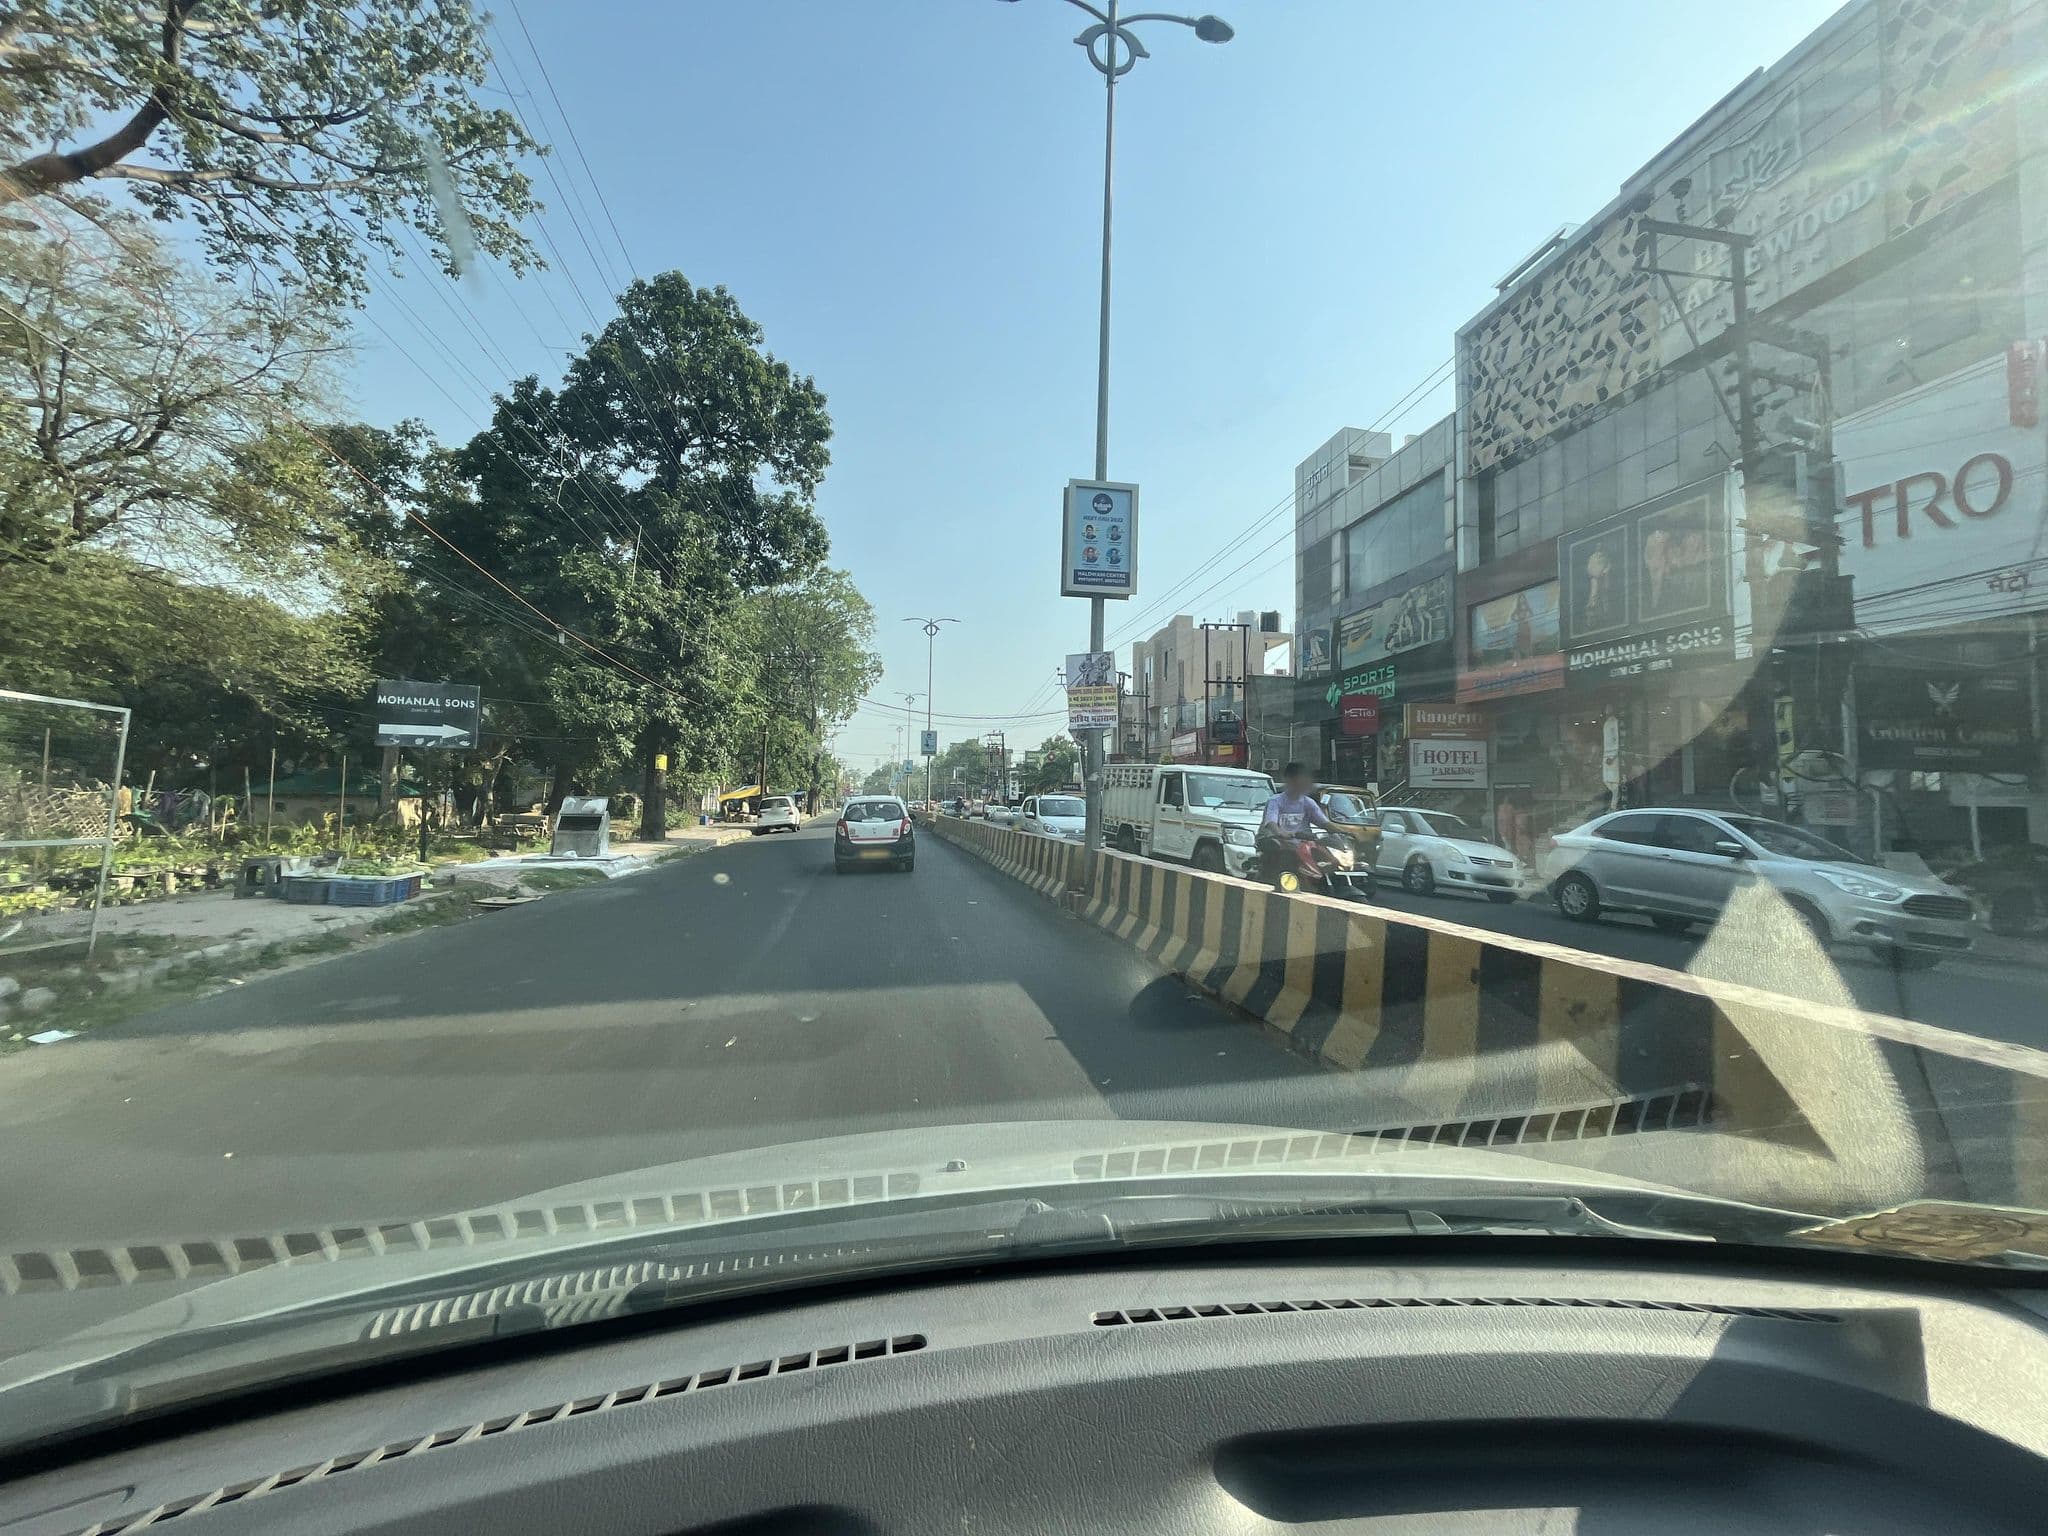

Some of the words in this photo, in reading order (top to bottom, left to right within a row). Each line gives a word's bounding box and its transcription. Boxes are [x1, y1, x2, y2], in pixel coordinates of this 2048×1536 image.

[1660, 172, 1877, 332] MAPEWOOD
[1569, 639, 1660, 671] MOHANLAL
[1665, 626, 1722, 653] SONS
[1343, 665, 1395, 690] SPORTS
[377, 695, 441, 707] MOHANLAL
[445, 699, 476, 709] SONS
[1423, 750, 1484, 765] HOTEL
[1431, 767, 1475, 776] PARKING
